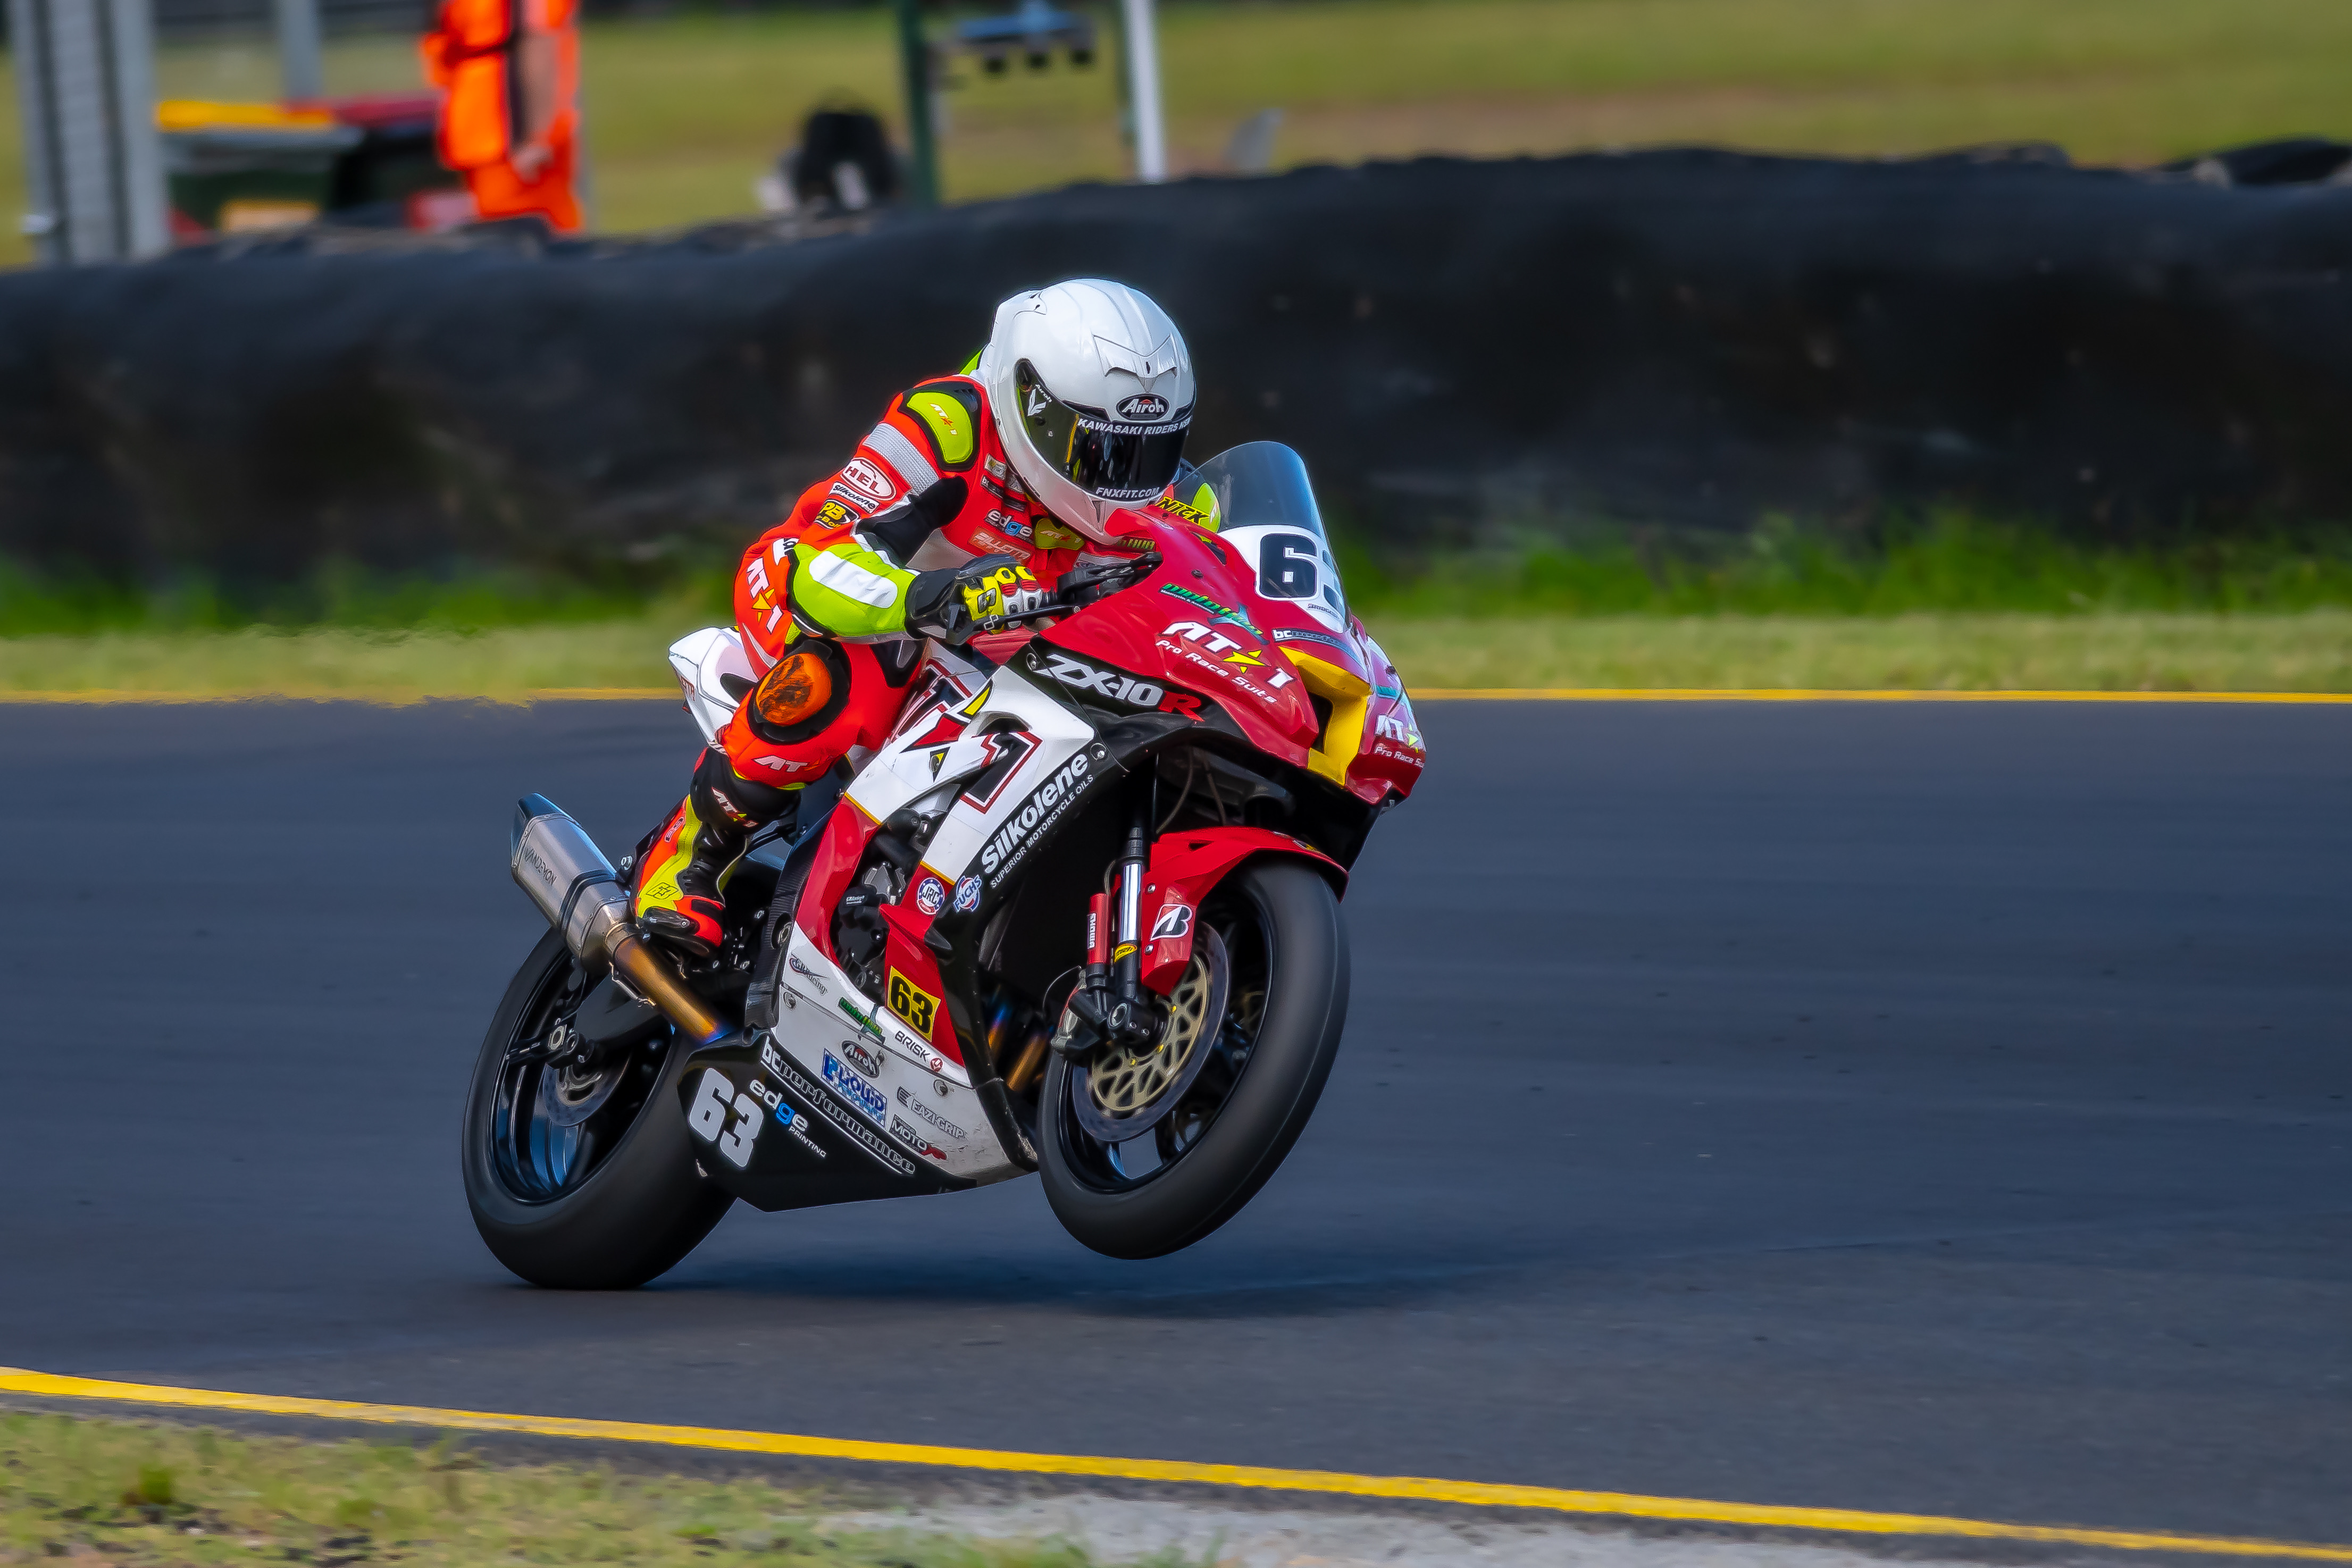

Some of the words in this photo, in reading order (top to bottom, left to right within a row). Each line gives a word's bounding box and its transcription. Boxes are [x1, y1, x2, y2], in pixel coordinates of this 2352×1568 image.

[1035, 384, 1052, 403] Airoh
[1121, 398, 1165, 413] Airoh
[1077, 418, 1142, 435] KAWASAKI
[1144, 423, 1178, 435] RIDERS
[844, 466, 880, 494] HEL
[1095, 487, 1160, 498] FNXFIT.COM
[819, 502, 846, 520] PB
[988, 510, 1033, 536] edge
[1155, 497, 1209, 526] NICK
[1156, 640, 1183, 654] Pro
[1185, 652, 1229, 676] Race
[1232, 676, 1277, 703] Suits
[1374, 746, 1393, 757] Pro
[1394, 751, 1414, 764] Race
[981, 753, 1088, 874] Silkolene
[991, 846, 1026, 889] SUPERIOR
[1027, 792, 1075, 846] MOTORCYCLE
[1075, 774, 1094, 796] OILS
[923, 886, 940, 904] JRC
[953, 874, 982, 912] FUCHS
[891, 975, 935, 1036] 63
[844, 1044, 876, 1075] Airoh
[894, 1030, 930, 1063] BRISK
[688, 1068, 764, 1168] 63
[749, 1079, 808, 1133] edge
[788, 1125, 827, 1158] PRINTING
